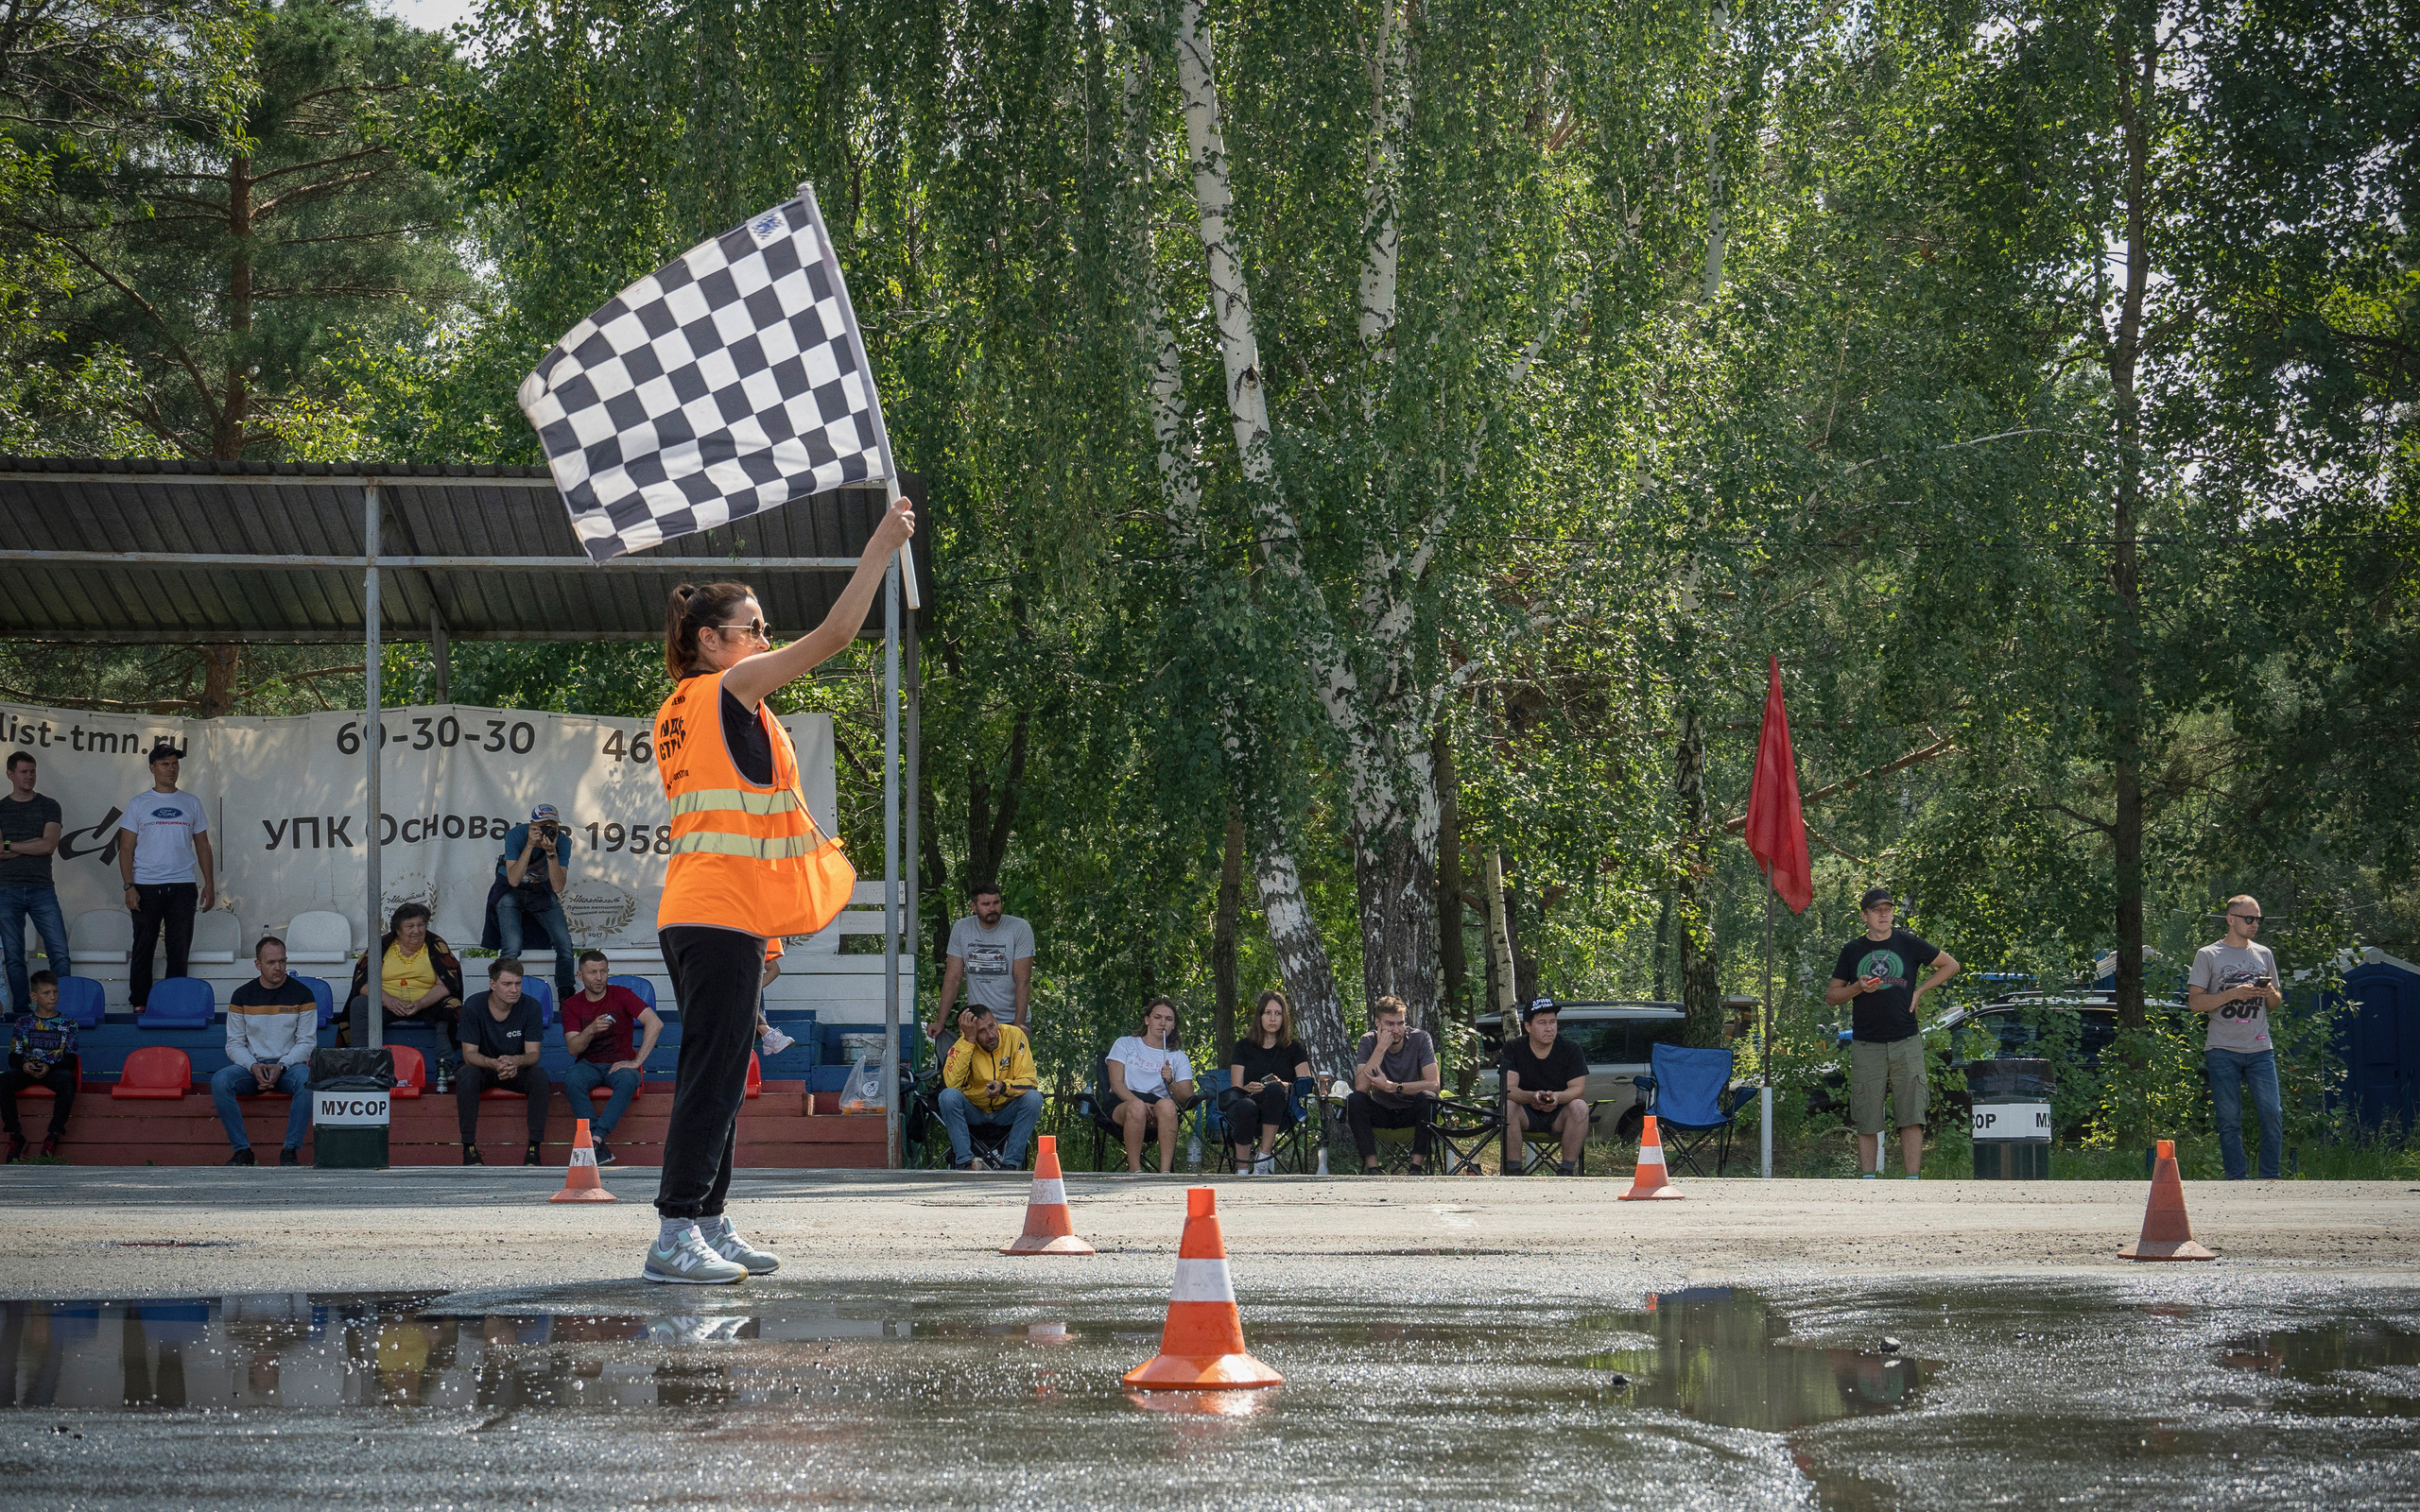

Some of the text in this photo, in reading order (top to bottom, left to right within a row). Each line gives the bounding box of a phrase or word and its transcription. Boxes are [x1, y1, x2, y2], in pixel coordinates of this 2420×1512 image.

[262, 816, 354, 850] УПК
[366, 813, 524, 847] Основа
[584, 821, 672, 855] 1958
[2221, 1005, 2259, 1019] OUT
[321, 1100, 387, 1116] МУСОР
[671, 1251, 699, 1273] N
